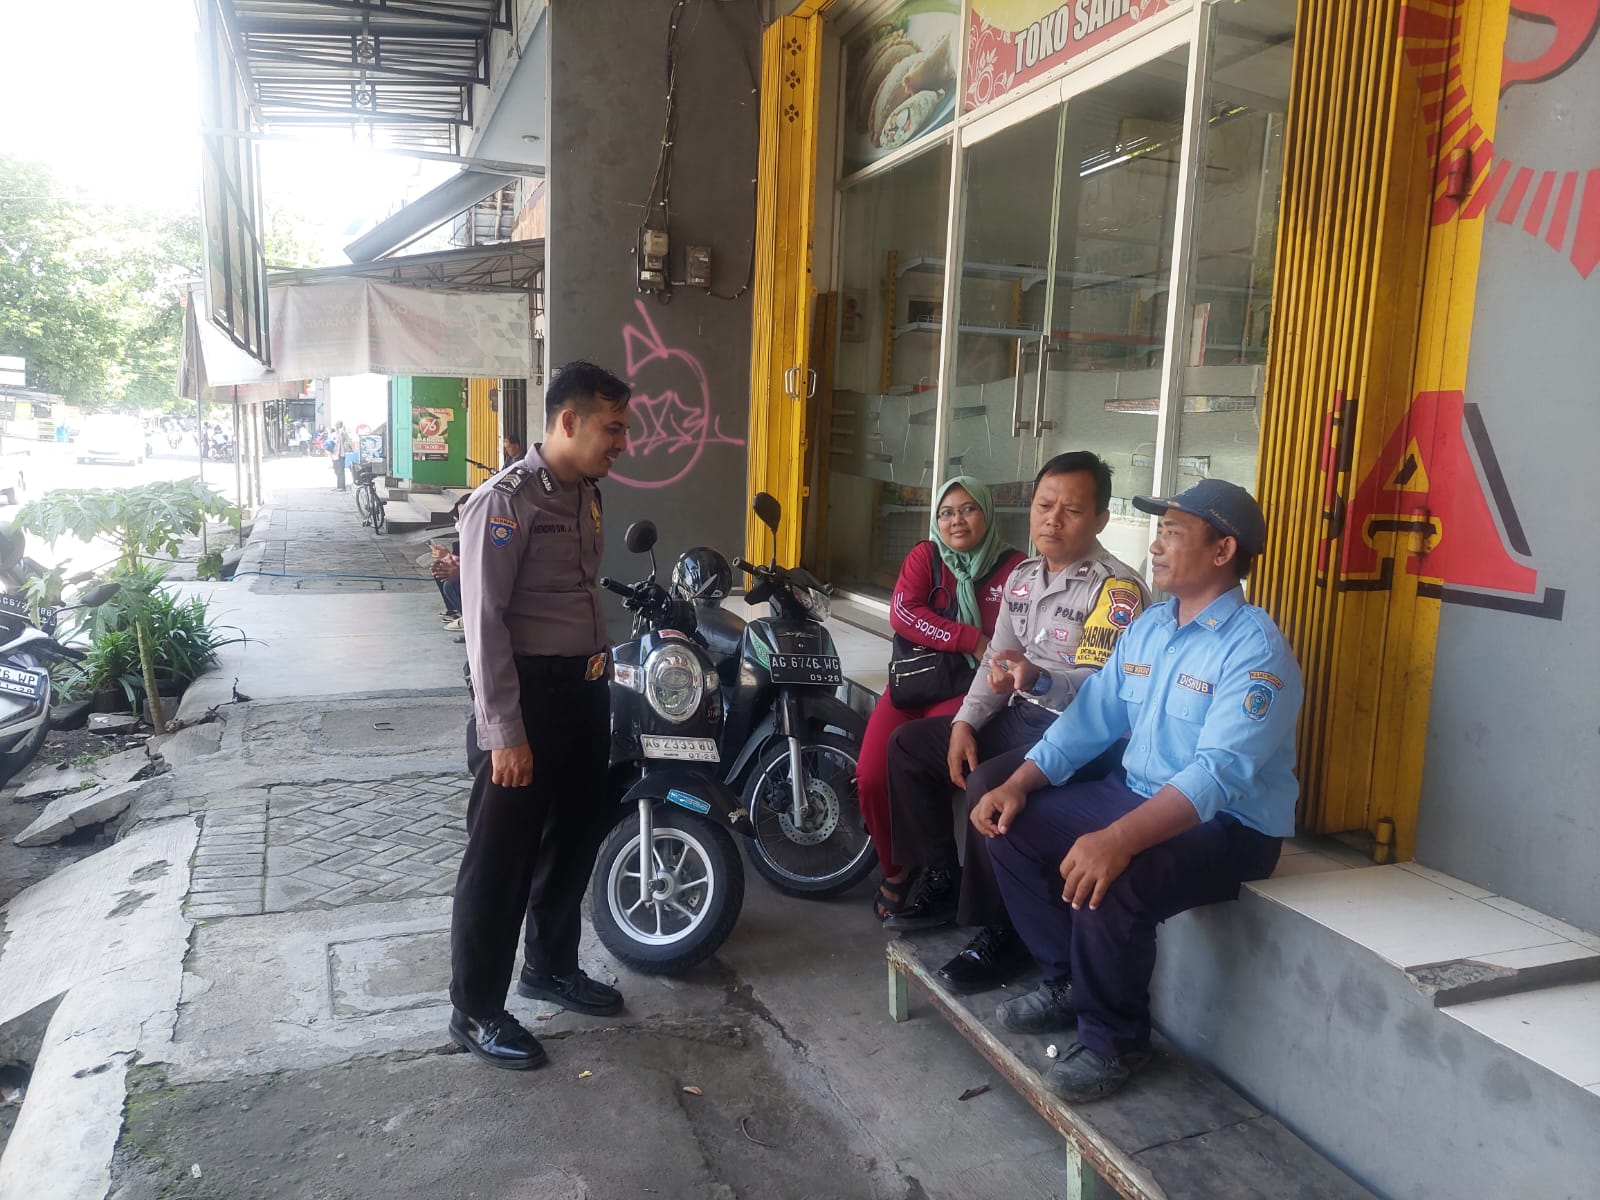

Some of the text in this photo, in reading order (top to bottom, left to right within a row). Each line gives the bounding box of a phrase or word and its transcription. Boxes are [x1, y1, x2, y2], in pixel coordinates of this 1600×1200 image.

[1014, 4, 1070, 74] TOKO
[420, 419, 437, 434] 76
[1054, 606, 1085, 622] POLR
[915, 618, 951, 642] adidas
[772, 656, 839, 670] AG 6746 WG
[18, 673, 35, 685] WP
[1179, 675, 1209, 693] DISHUB
